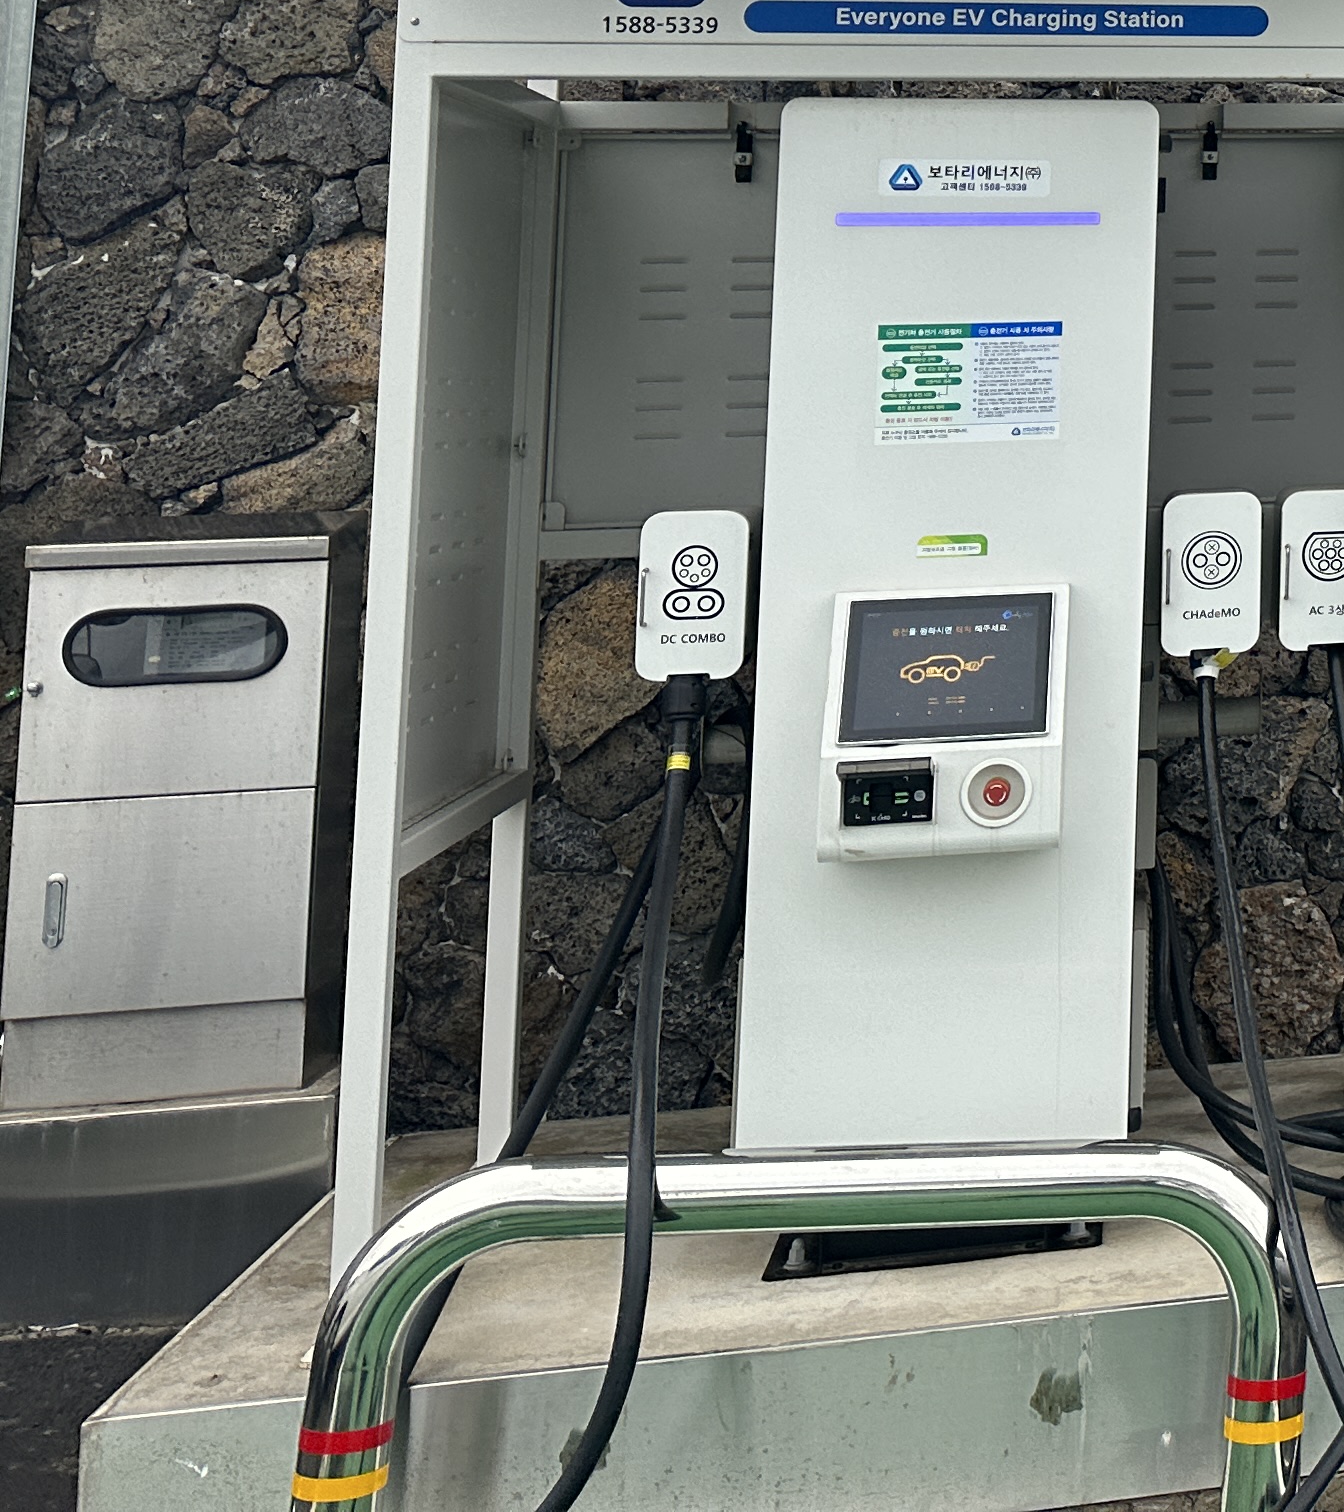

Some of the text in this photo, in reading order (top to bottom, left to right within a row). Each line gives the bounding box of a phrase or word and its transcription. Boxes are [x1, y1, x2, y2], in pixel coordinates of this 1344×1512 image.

[602, 15, 719, 34] 1588-5339
[835, 7, 1185, 33] Everyone EV Charging Station
[1182, 607, 1241, 620] CHAdeMO
[1308, 605, 1325, 616] AC
[660, 633, 726, 645] DC COMBO
